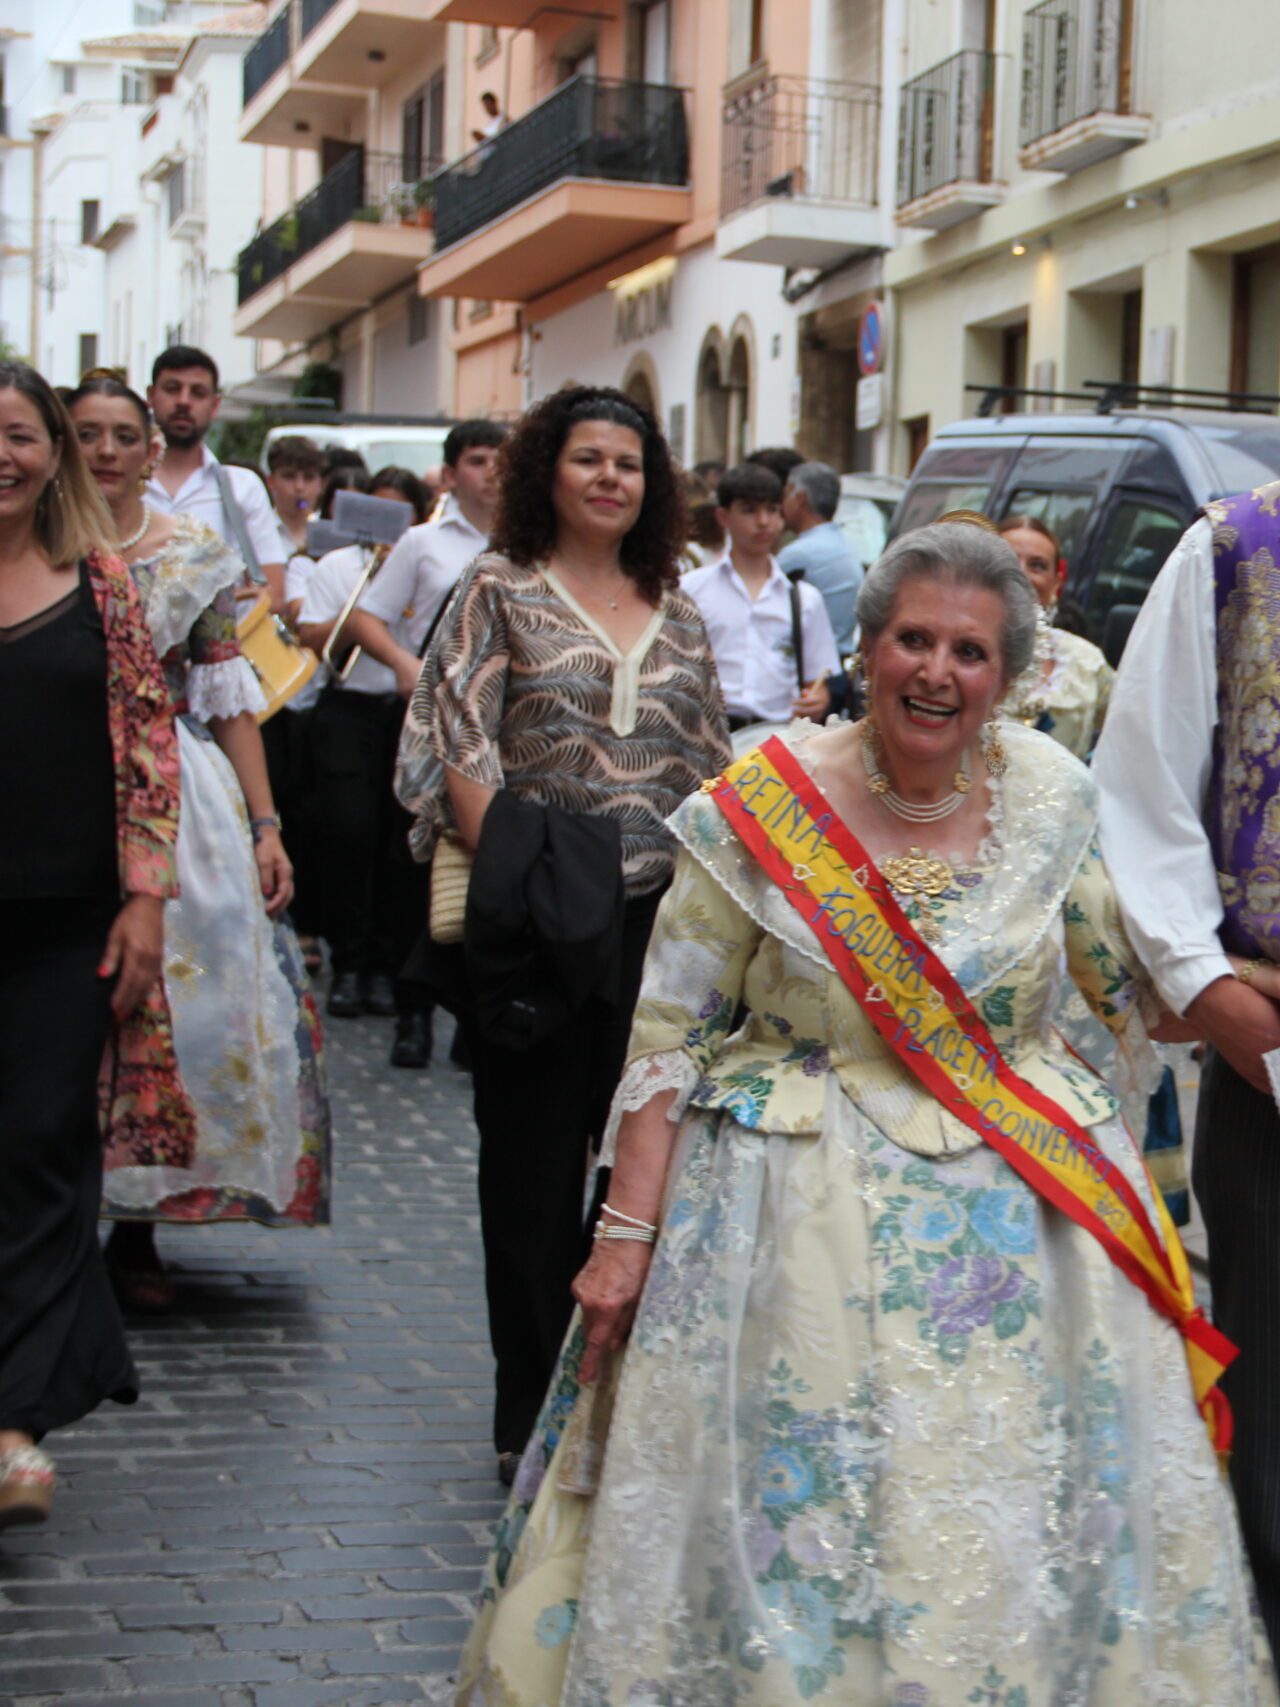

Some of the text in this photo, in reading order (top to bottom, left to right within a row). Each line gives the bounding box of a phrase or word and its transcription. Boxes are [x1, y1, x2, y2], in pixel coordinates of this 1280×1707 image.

[720, 764, 1111, 1183] REINA FOGUERA PLACETA CONVENTO
